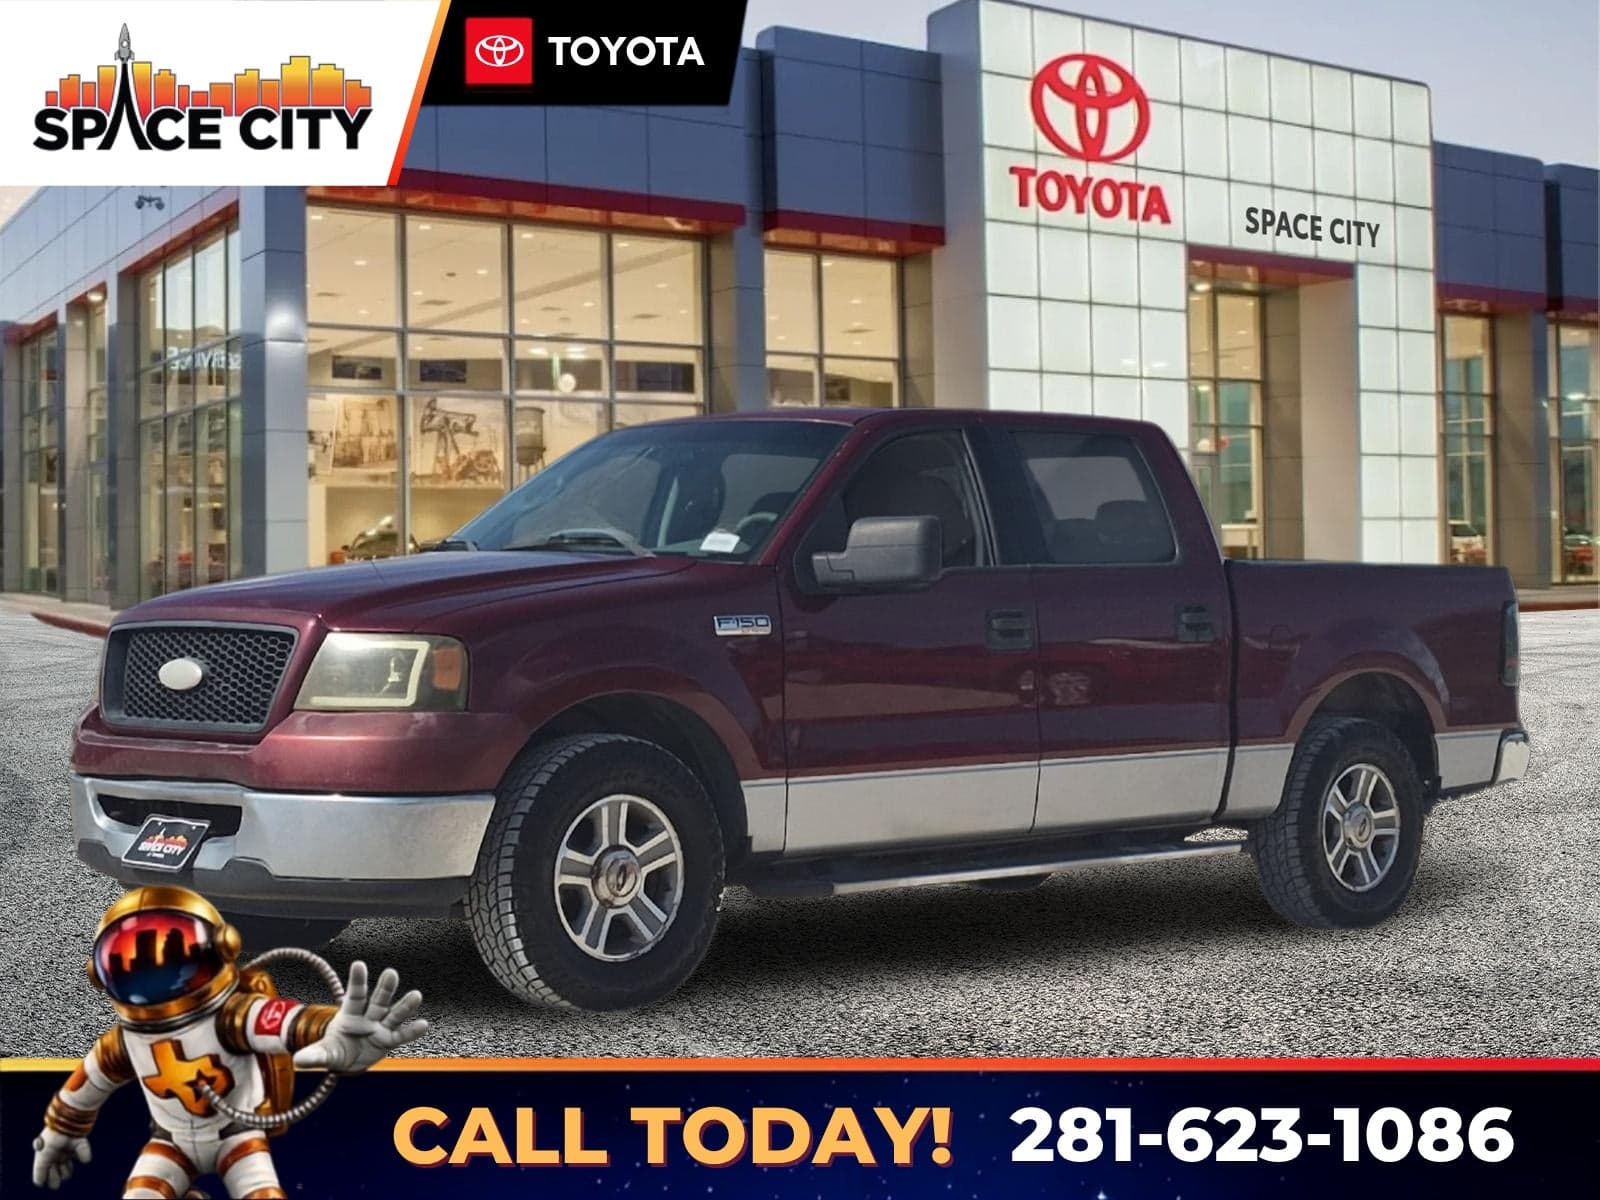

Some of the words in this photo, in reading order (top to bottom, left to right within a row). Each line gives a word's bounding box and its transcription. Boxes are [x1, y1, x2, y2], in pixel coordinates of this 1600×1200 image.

[1008, 165, 1172, 225] TOYOTA
[1245, 206, 1323, 242] SPACE
[1329, 217, 1381, 248] CITY
